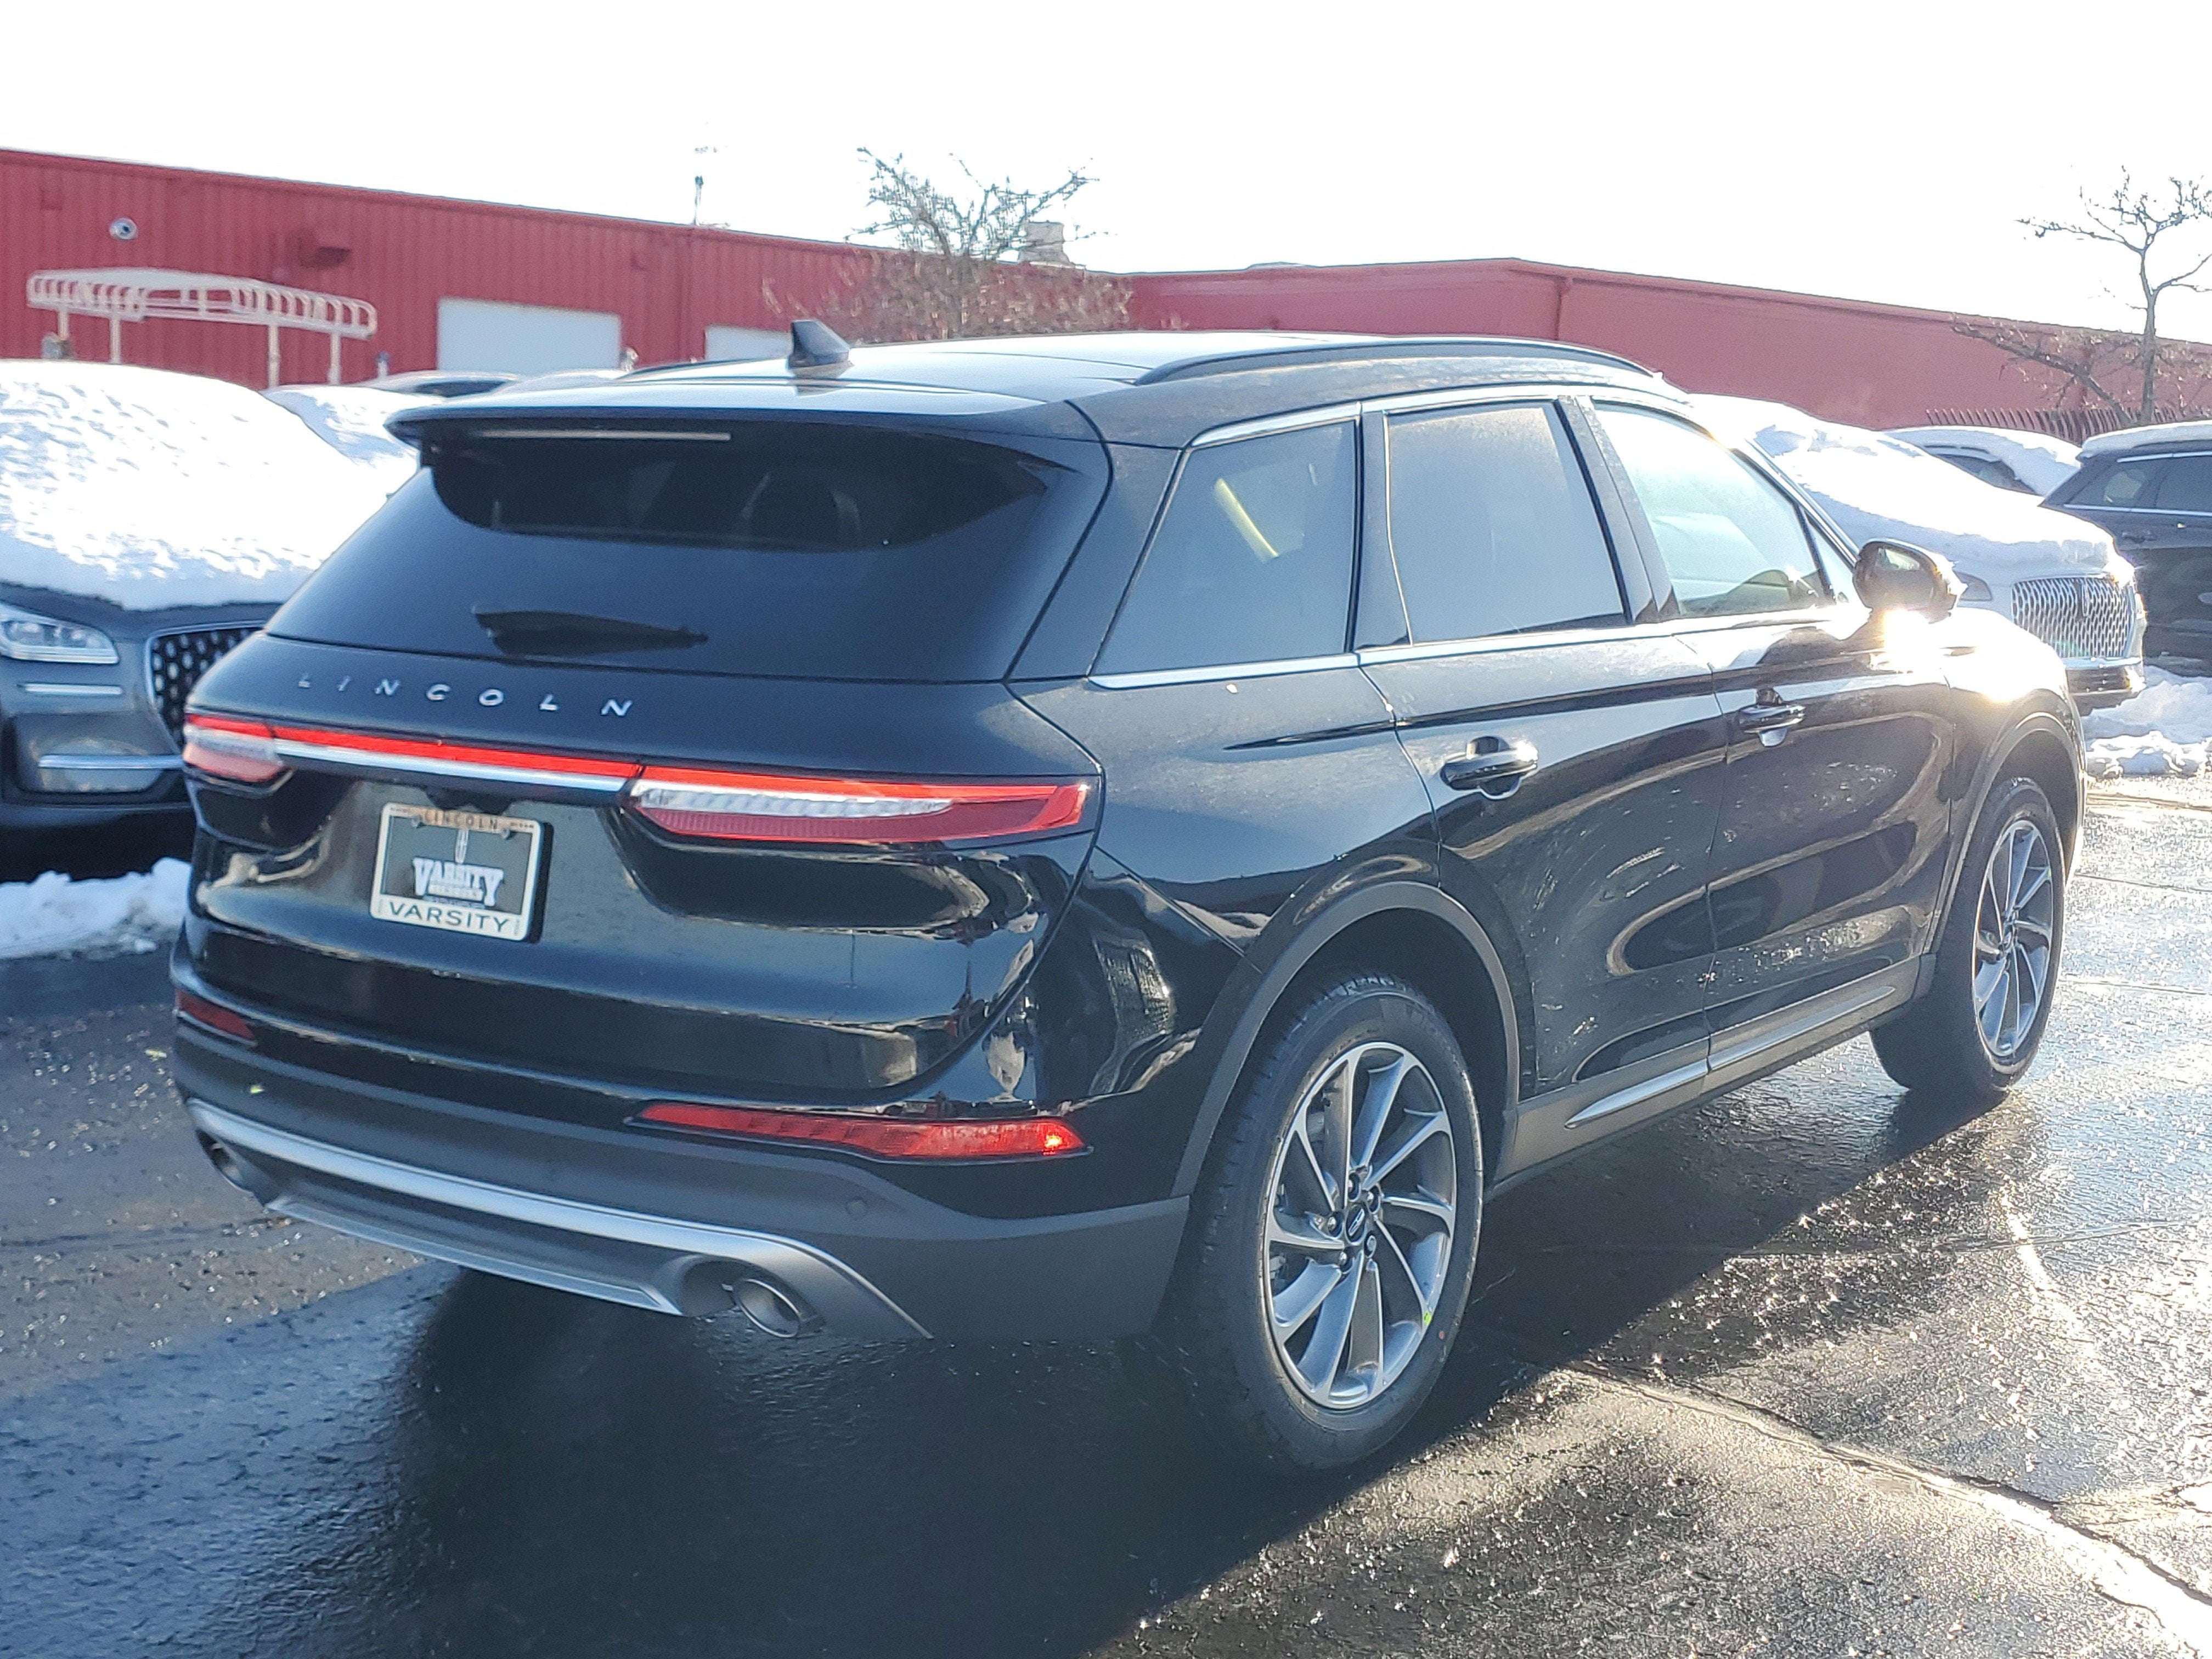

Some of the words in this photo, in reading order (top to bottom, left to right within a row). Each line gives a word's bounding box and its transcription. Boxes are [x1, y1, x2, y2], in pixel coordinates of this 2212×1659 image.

[298, 674, 632, 716] LINCOLN
[422, 808, 498, 830] LINCOLN
[390, 901, 509, 932] VARSITY
